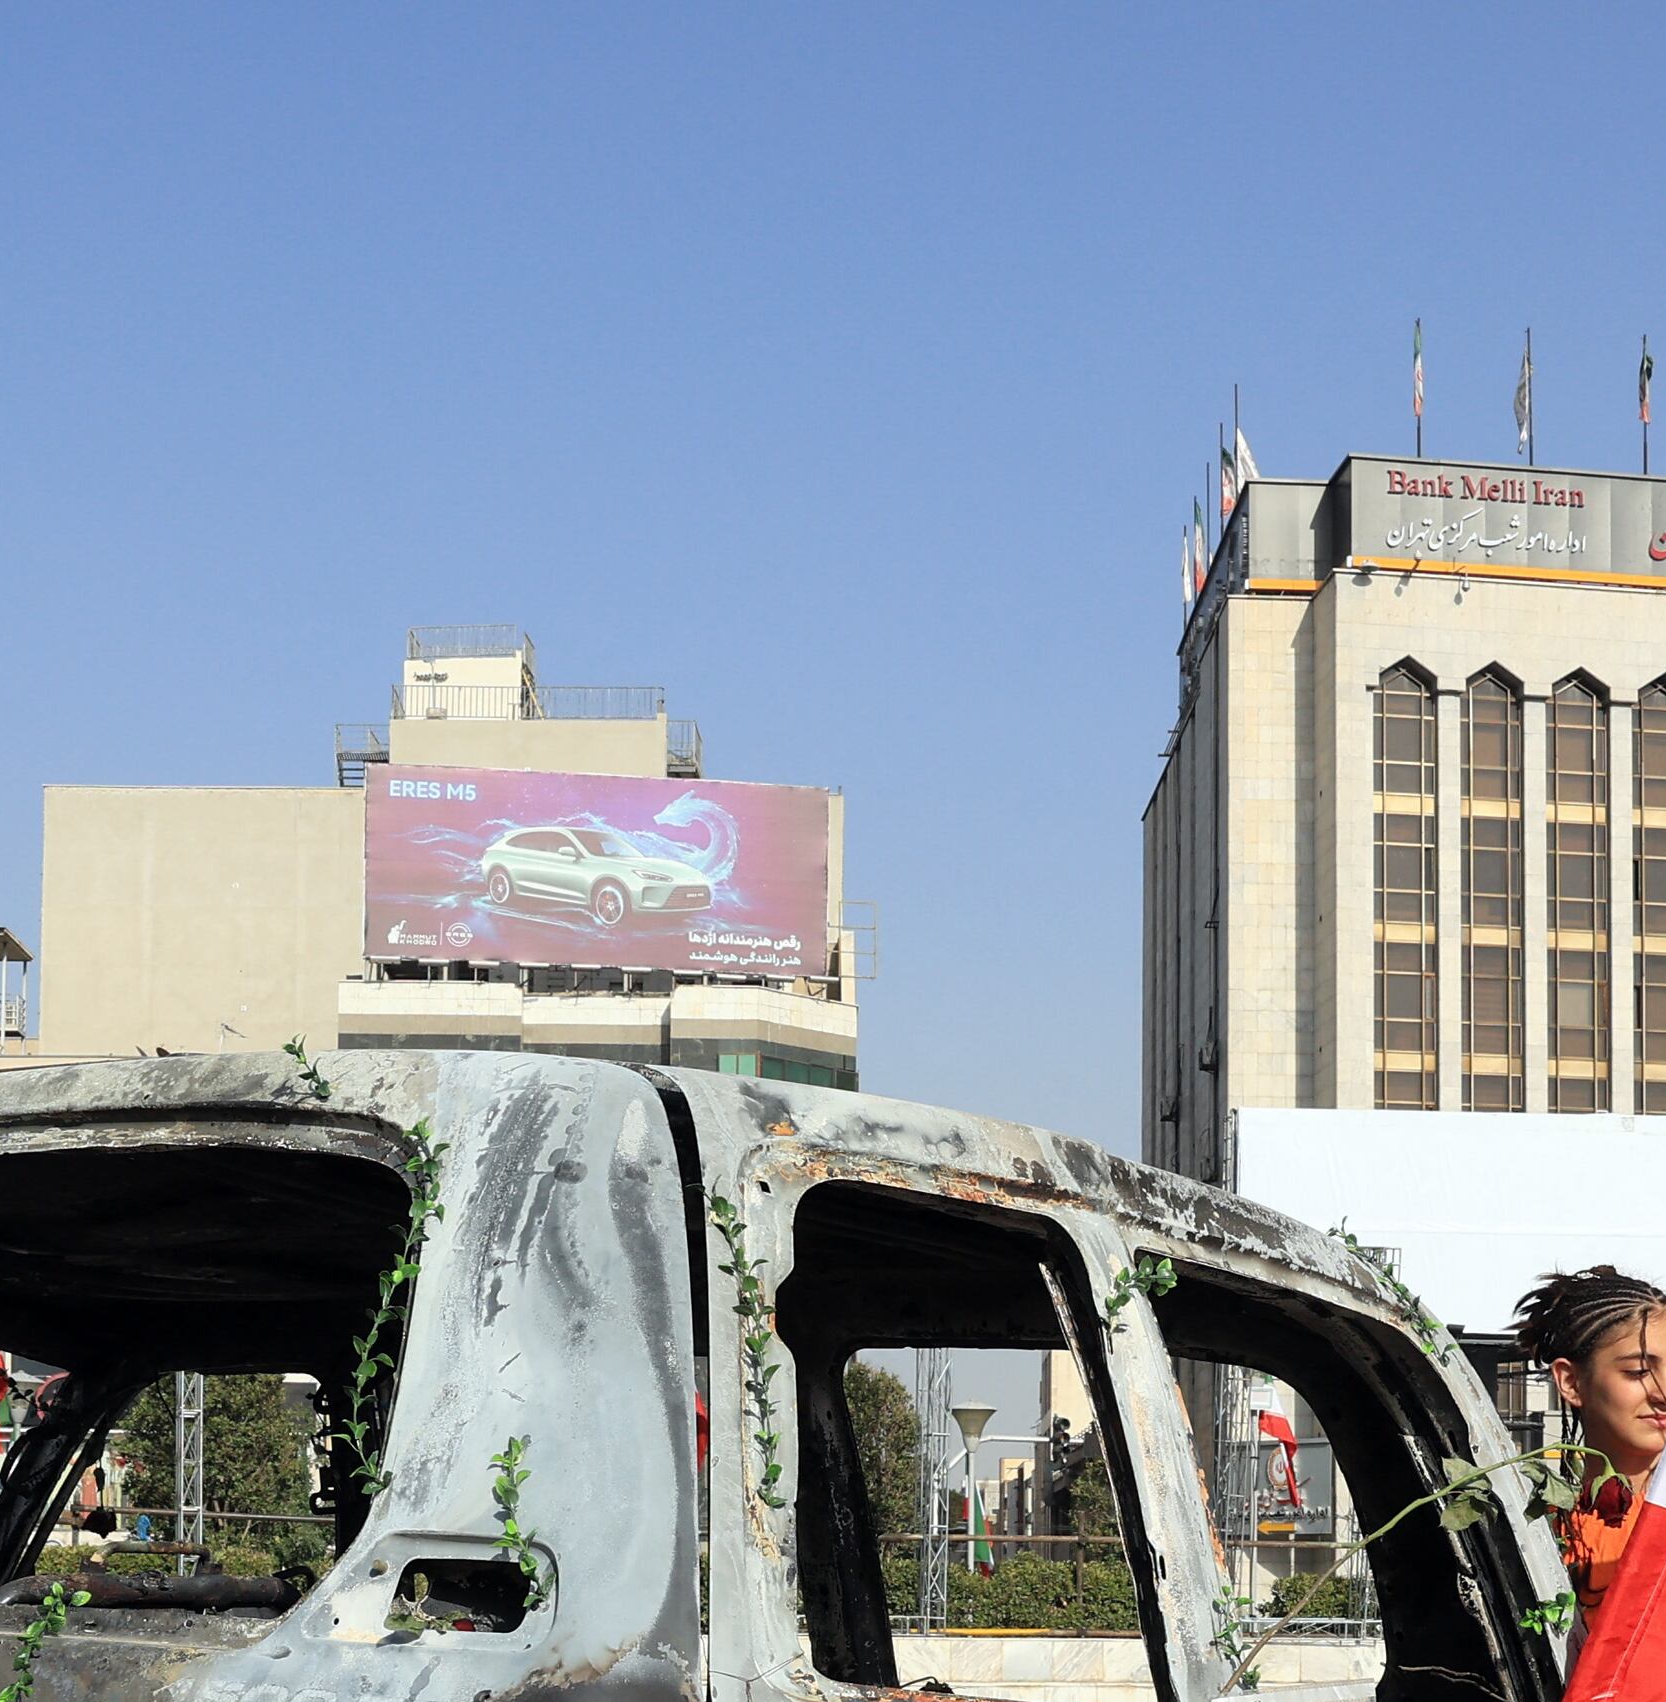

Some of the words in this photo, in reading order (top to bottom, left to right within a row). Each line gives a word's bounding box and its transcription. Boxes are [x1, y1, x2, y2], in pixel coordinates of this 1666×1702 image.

[1387, 469, 1454, 499] Bank
[1460, 475, 1526, 504] Melli
[1532, 480, 1586, 509] Iran
[1386, 517, 1432, 549] تهران
[1428, 507, 1485, 553] مرکزی
[1478, 513, 1521, 558] شعب
[1516, 531, 1549, 552] امور
[1548, 529, 1587, 554] اداره
[389, 779, 441, 800] ERES
[446, 783, 477, 802] M5
[688, 930, 717, 947] اژدها
[718, 932, 772, 949] هنرمندانه
[773, 934, 801, 951] رقص
[689, 949, 738, 964] هوشمند
[739, 951, 780, 967] رانندگی
[780, 954, 802, 967] هنر
